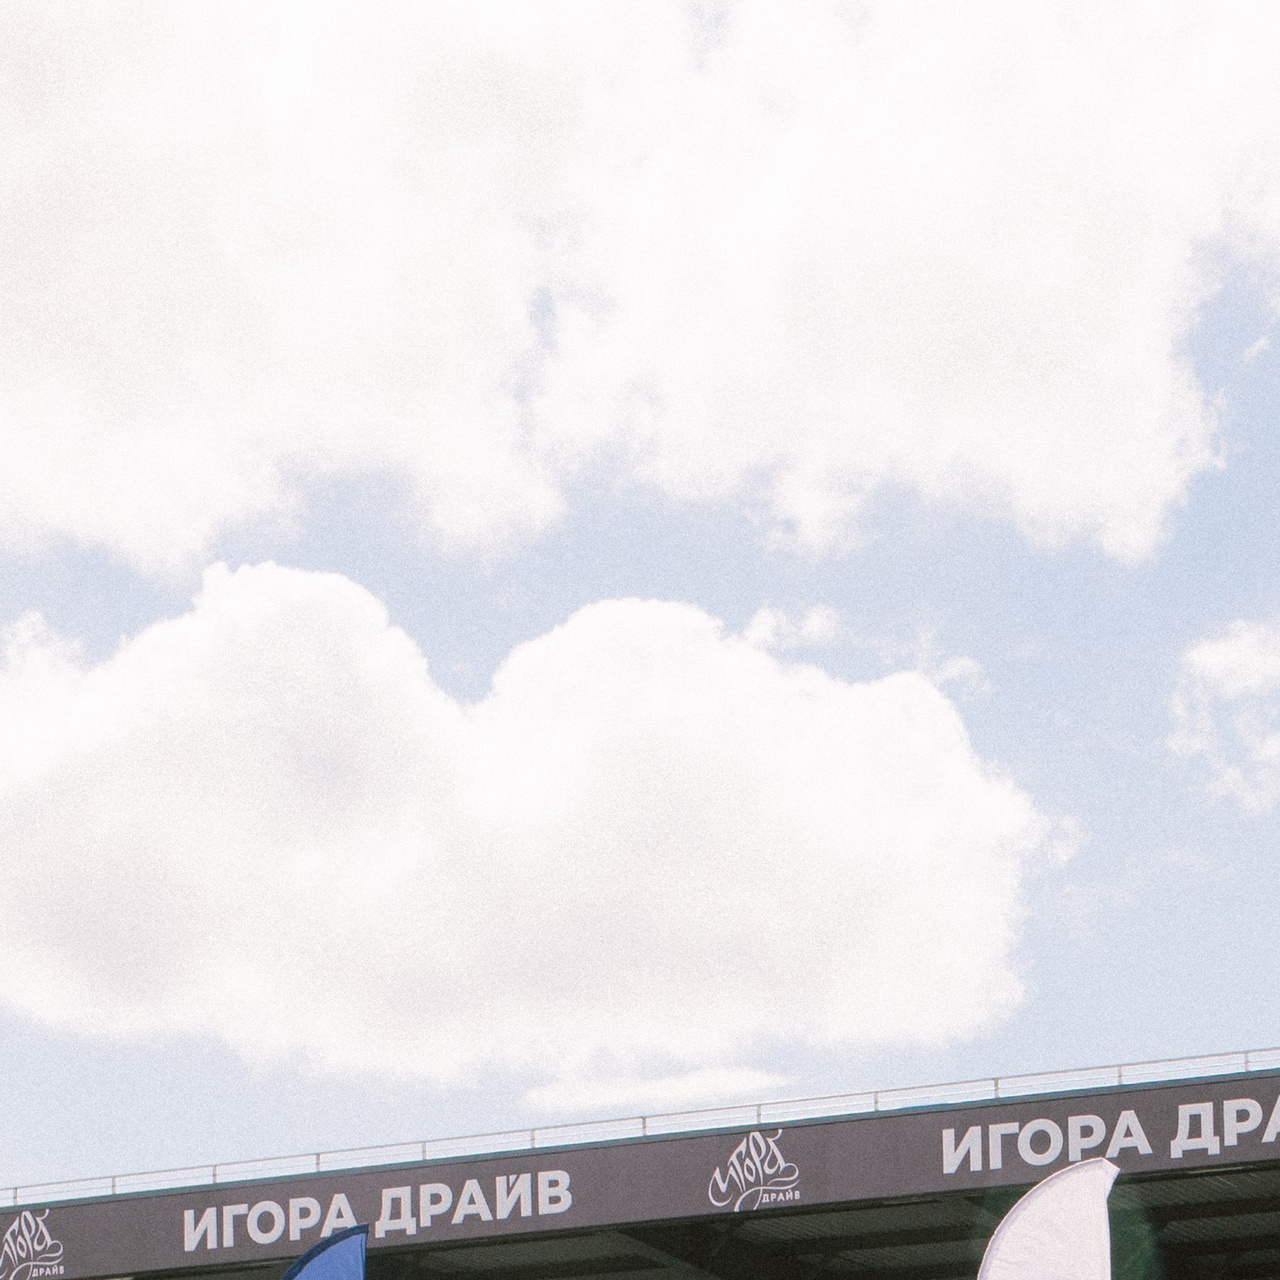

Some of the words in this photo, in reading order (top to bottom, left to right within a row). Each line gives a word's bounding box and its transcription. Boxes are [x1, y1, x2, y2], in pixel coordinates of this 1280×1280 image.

[942, 1110, 1152, 1175] ИГОРА
[184, 1193, 358, 1252] ИГОРА
[374, 1169, 573, 1238] ДРАЙВ
[762, 1190, 801, 1203] ДРАЙВ
